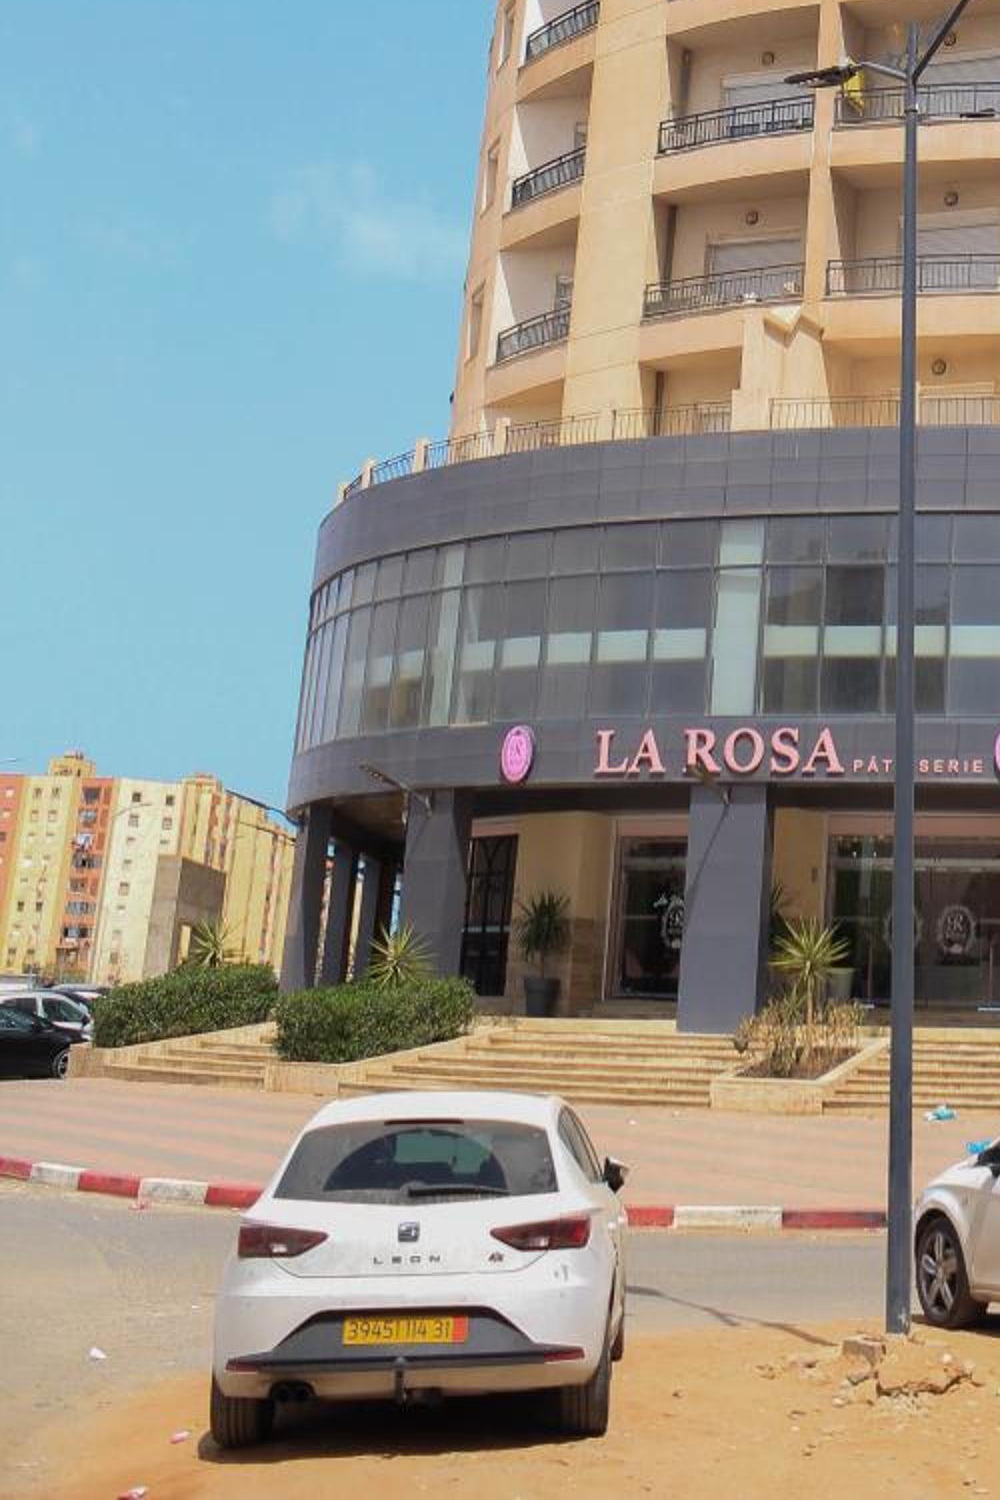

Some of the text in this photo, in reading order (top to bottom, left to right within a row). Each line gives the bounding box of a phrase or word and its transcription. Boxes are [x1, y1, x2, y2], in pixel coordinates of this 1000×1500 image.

[594, 727, 984, 774] LA ROSA PÂTSERIE
[373, 1255, 441, 1265] LEON
